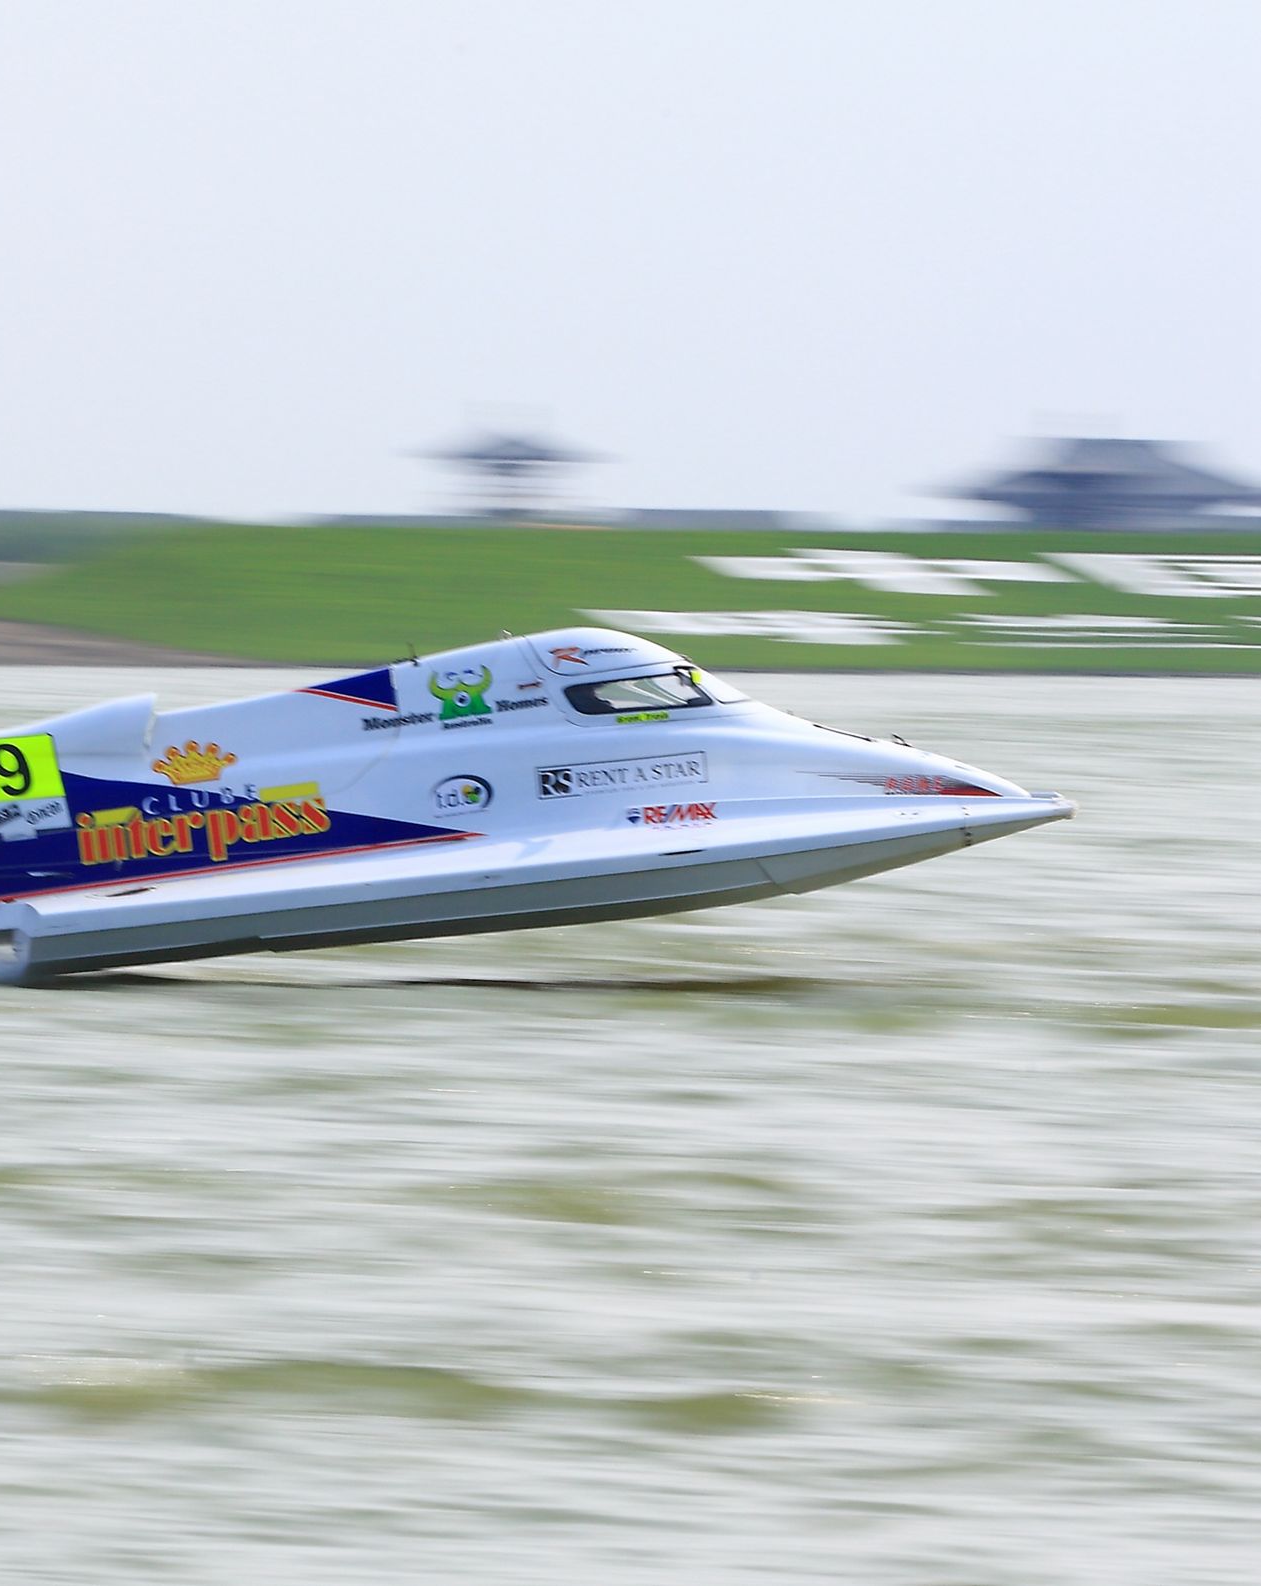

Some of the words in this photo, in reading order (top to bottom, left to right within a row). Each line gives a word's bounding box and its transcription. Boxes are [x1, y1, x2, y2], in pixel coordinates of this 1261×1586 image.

[361, 712, 434, 731] Monster
[495, 697, 549, 713] Homes
[539, 771, 573, 796] RS
[576, 767, 629, 788] RENT
[635, 766, 649, 783] A
[652, 760, 701, 780] STAR
[142, 782, 257, 817] CLUBE
[643, 802, 718, 825] RE/MAX
[76, 797, 331, 862] interpass
